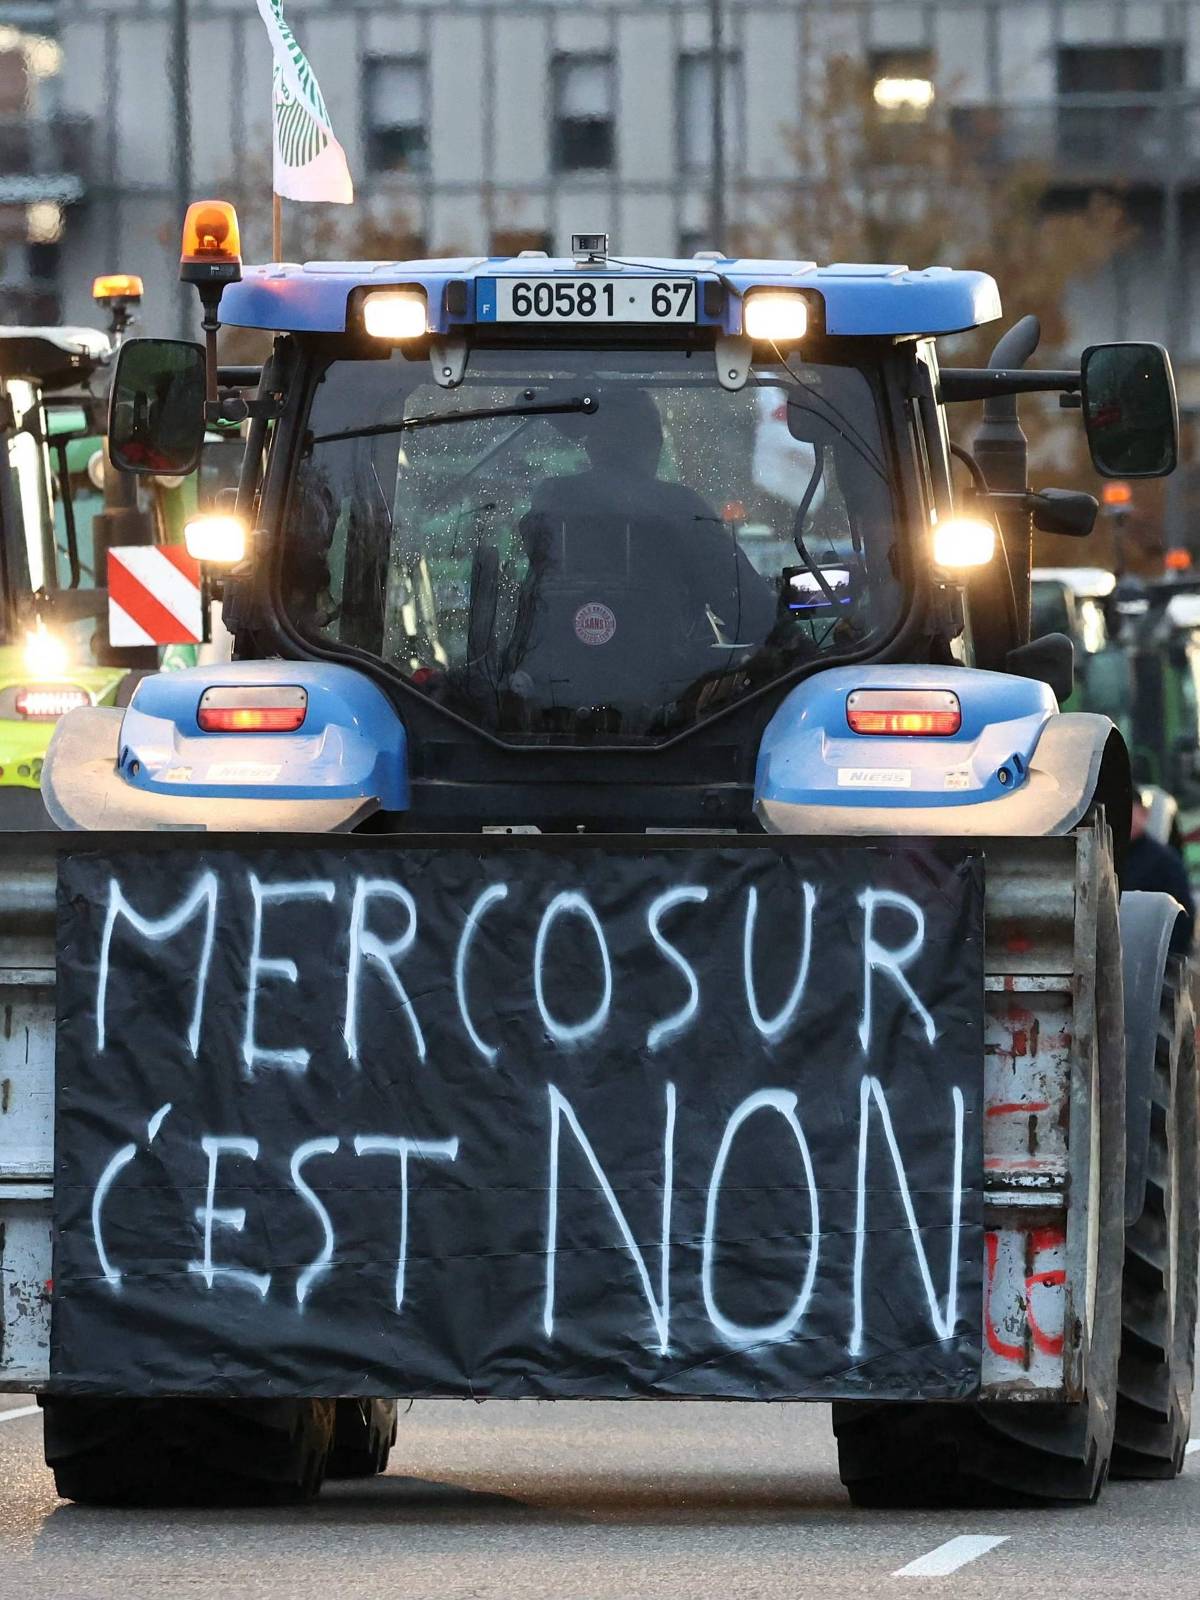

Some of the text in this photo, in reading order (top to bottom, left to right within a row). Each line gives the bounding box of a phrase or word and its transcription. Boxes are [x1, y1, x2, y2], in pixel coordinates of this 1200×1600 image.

[482, 282, 693, 317] F 60581 67
[96, 870, 938, 1075] MERCOSUR
[91, 1102, 460, 1312] C'EST
[543, 1074, 966, 1359] NON
